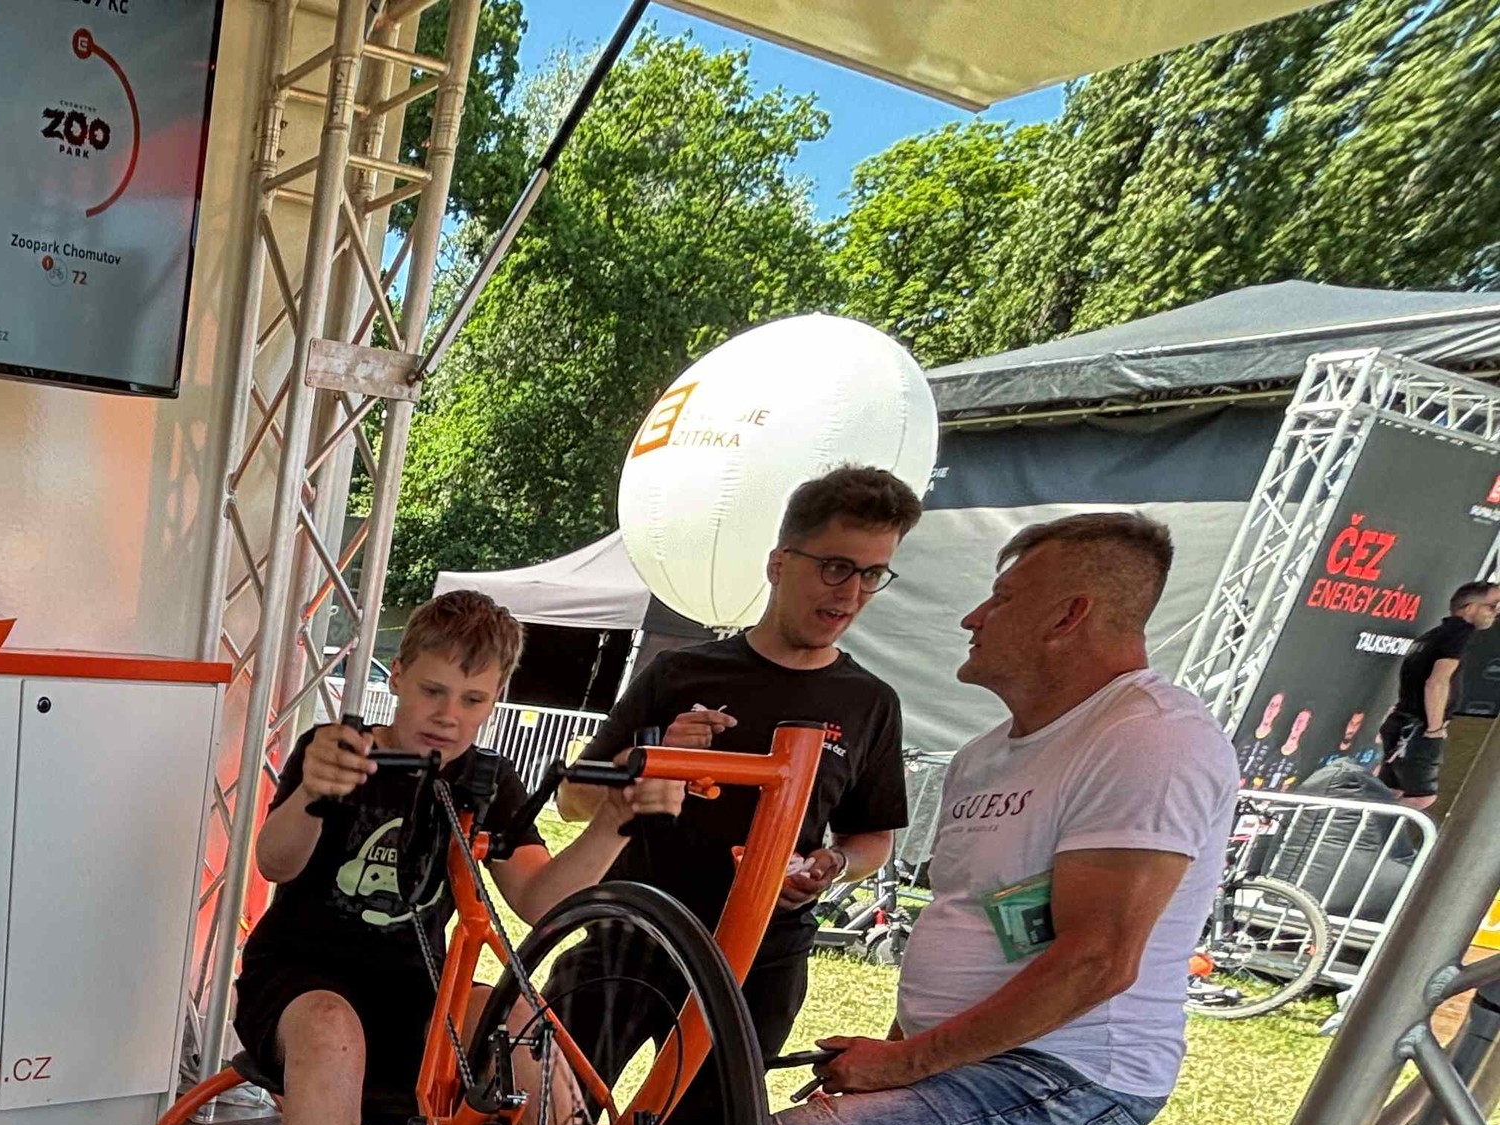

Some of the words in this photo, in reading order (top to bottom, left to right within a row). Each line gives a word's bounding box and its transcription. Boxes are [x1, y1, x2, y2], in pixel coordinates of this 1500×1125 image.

[41, 107, 111, 151] ZOO
[59, 144, 89, 159] PARK
[10, 233, 60, 255] Zoopark
[62, 243, 122, 266] Chomutov
[72, 270, 88, 286] 72
[1326, 513, 1396, 581] ČEZ
[1306, 578, 1376, 614] ENERGY
[1371, 584, 1421, 622] ZÓNA
[952, 788, 1034, 819] GUESS
